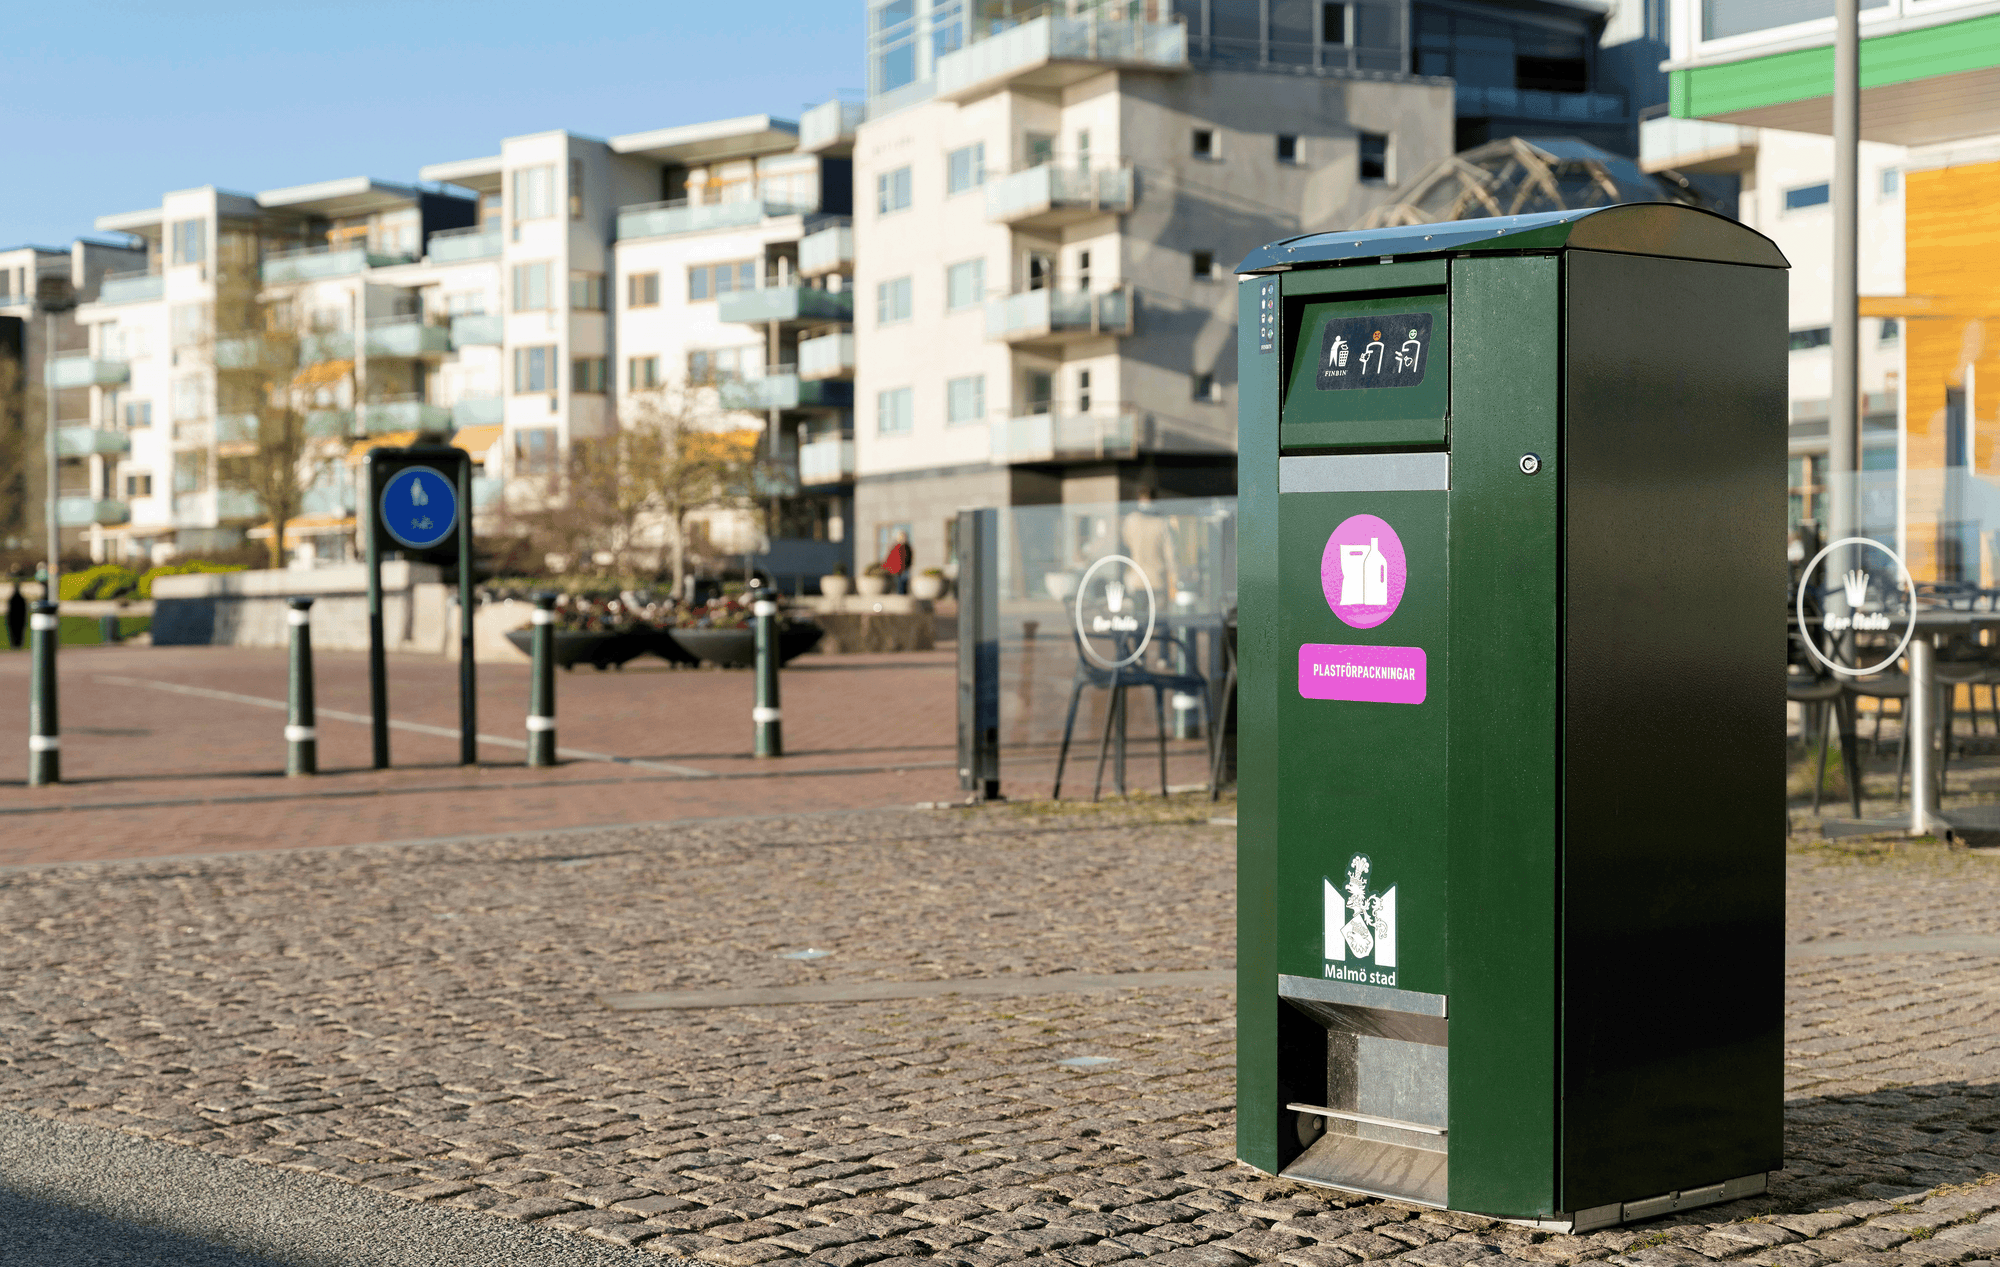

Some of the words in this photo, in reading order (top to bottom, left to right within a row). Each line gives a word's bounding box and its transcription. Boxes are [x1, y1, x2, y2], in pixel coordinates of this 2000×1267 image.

[1313, 662, 1416, 681] PLASTFÖRPACKNINGAR
[1324, 963, 1367, 982] Malmö
[1369, 971, 1396, 986] stad
